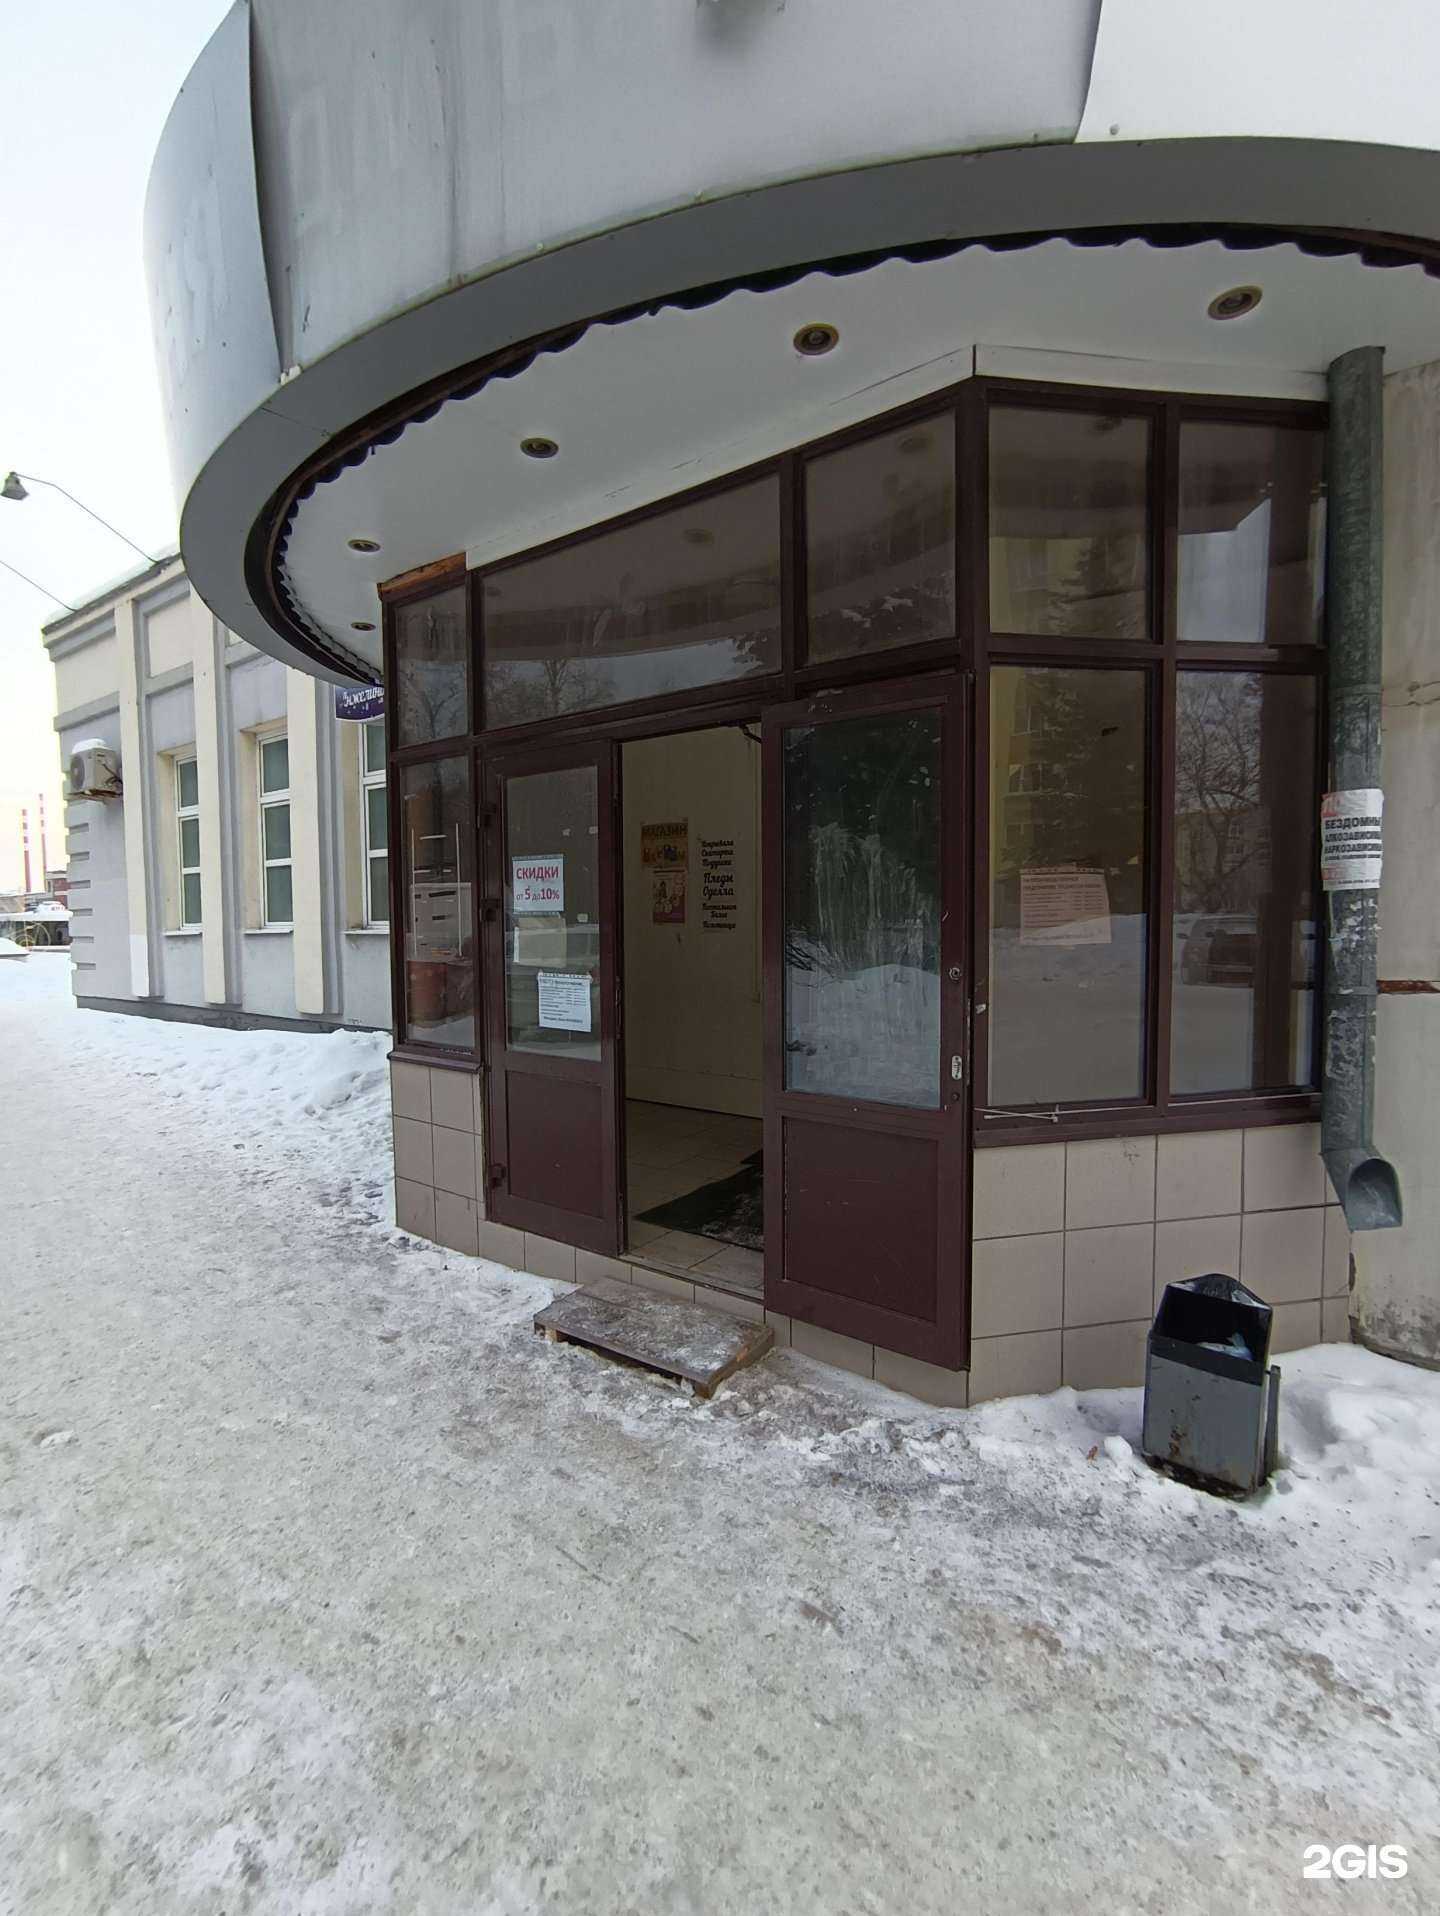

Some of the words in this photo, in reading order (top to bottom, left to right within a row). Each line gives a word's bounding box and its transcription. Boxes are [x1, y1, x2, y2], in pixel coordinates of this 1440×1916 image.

[516, 866, 559, 881] СКИДКИ
[525, 888, 530, 900] 5
[541, 888, 560, 900] 10%
